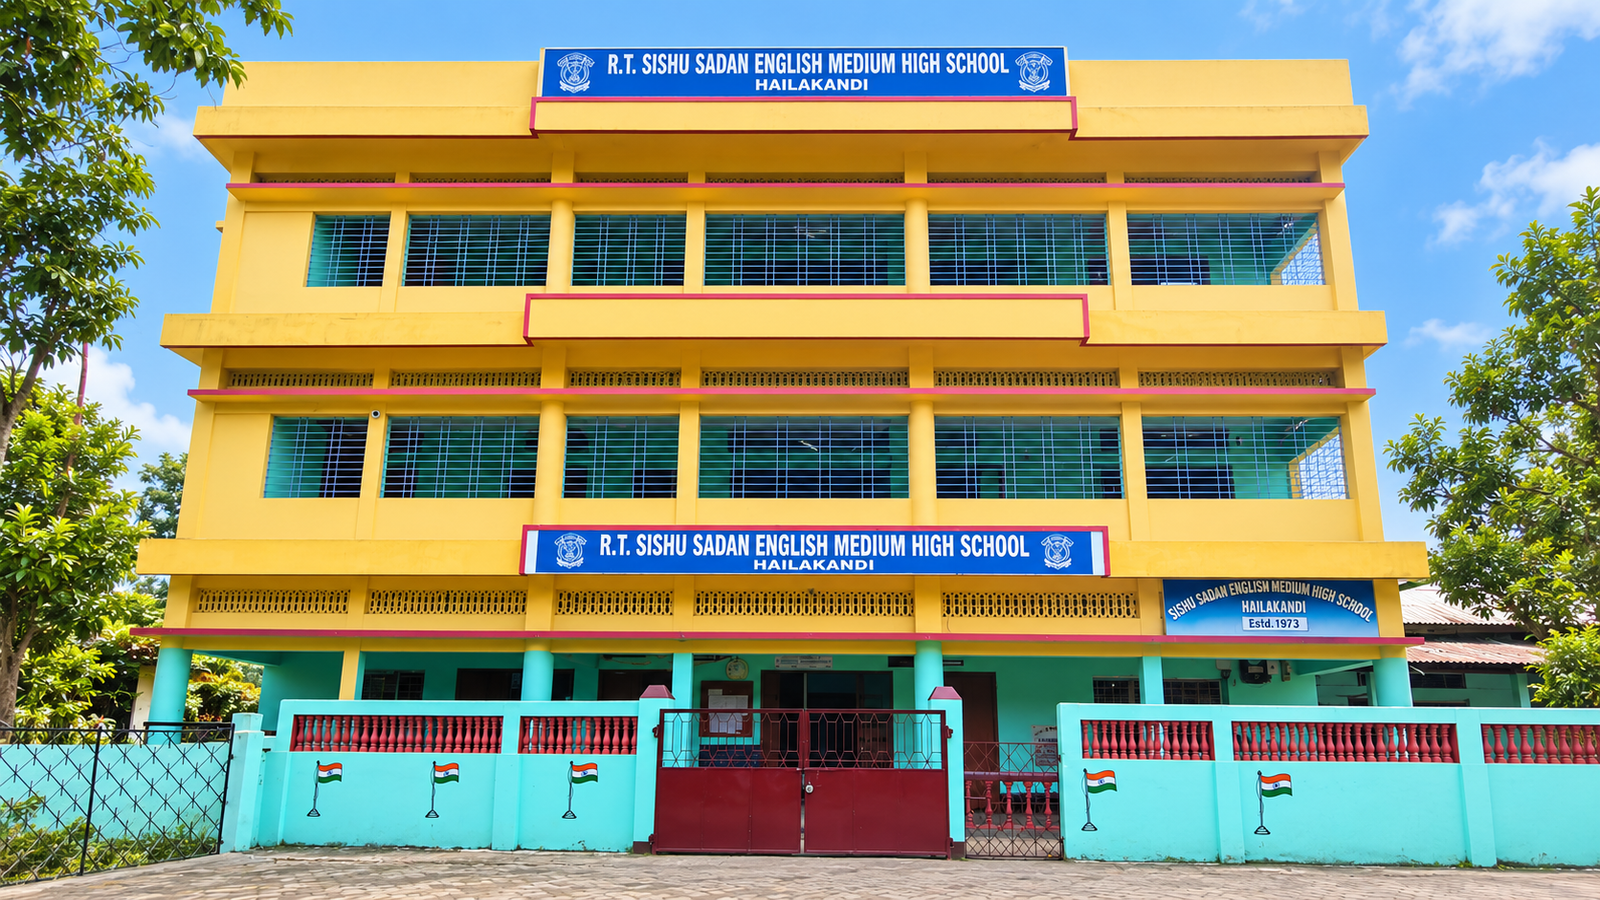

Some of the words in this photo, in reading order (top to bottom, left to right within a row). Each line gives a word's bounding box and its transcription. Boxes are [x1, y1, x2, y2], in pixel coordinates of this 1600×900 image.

[608, 54, 636, 75] R.T.
[642, 53, 690, 75] SISHU
[695, 53, 749, 75] SADAN
[755, 52, 822, 75] ENGLISH
[829, 52, 895, 74] MEDIUM
[902, 52, 940, 74] HIGH
[946, 52, 1010, 74] SCHOOL
[756, 79, 868, 91] HAILAKANDI
[600, 534, 630, 556] R.T.
[636, 534, 687, 556] SISHU
[693, 534, 749, 557] SADAN
[756, 534, 828, 557] ENGLISH
[835, 534, 905, 557] MEDIUM
[912, 535, 954, 557] HIGH
[960, 535, 1030, 558] SCHOOL
[754, 560, 874, 571] HAILAKANDI
[1167, 596, 1197, 621] SISHU
[1195, 584, 1229, 606] SADAN
[1228, 580, 1270, 596] ENGLISH
[1271, 580, 1310, 597] MEDIUM
[1311, 584, 1337, 603] HIGH
[1336, 593, 1374, 623] SCHOOL
[1242, 600, 1306, 613] HAILAKANDI
